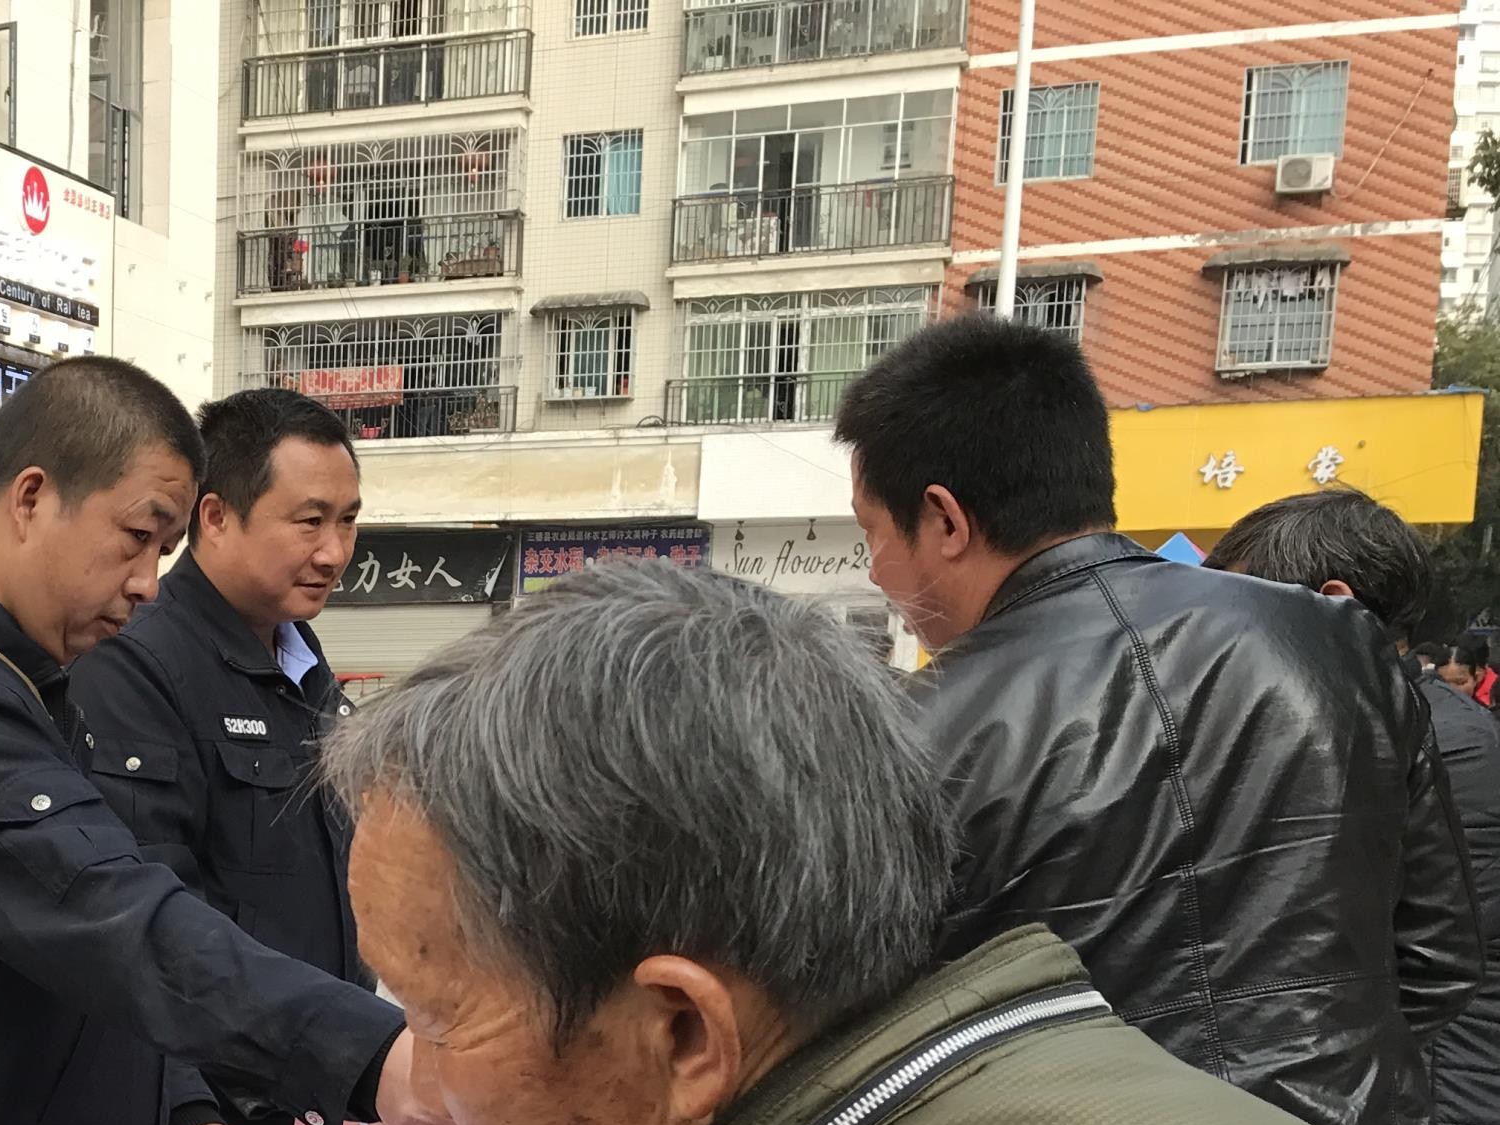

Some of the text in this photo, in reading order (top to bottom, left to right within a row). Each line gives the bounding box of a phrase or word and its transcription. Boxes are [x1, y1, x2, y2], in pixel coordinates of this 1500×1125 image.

[0, 279, 35, 308] Century
[41, 294, 51, 309] of
[77, 303, 91, 321] tea
[331, 551, 463, 594] 力女人
[725, 542, 767, 575] Sun
[762, 540, 850, 586] flower
[224, 717, 267, 736] 52H300
